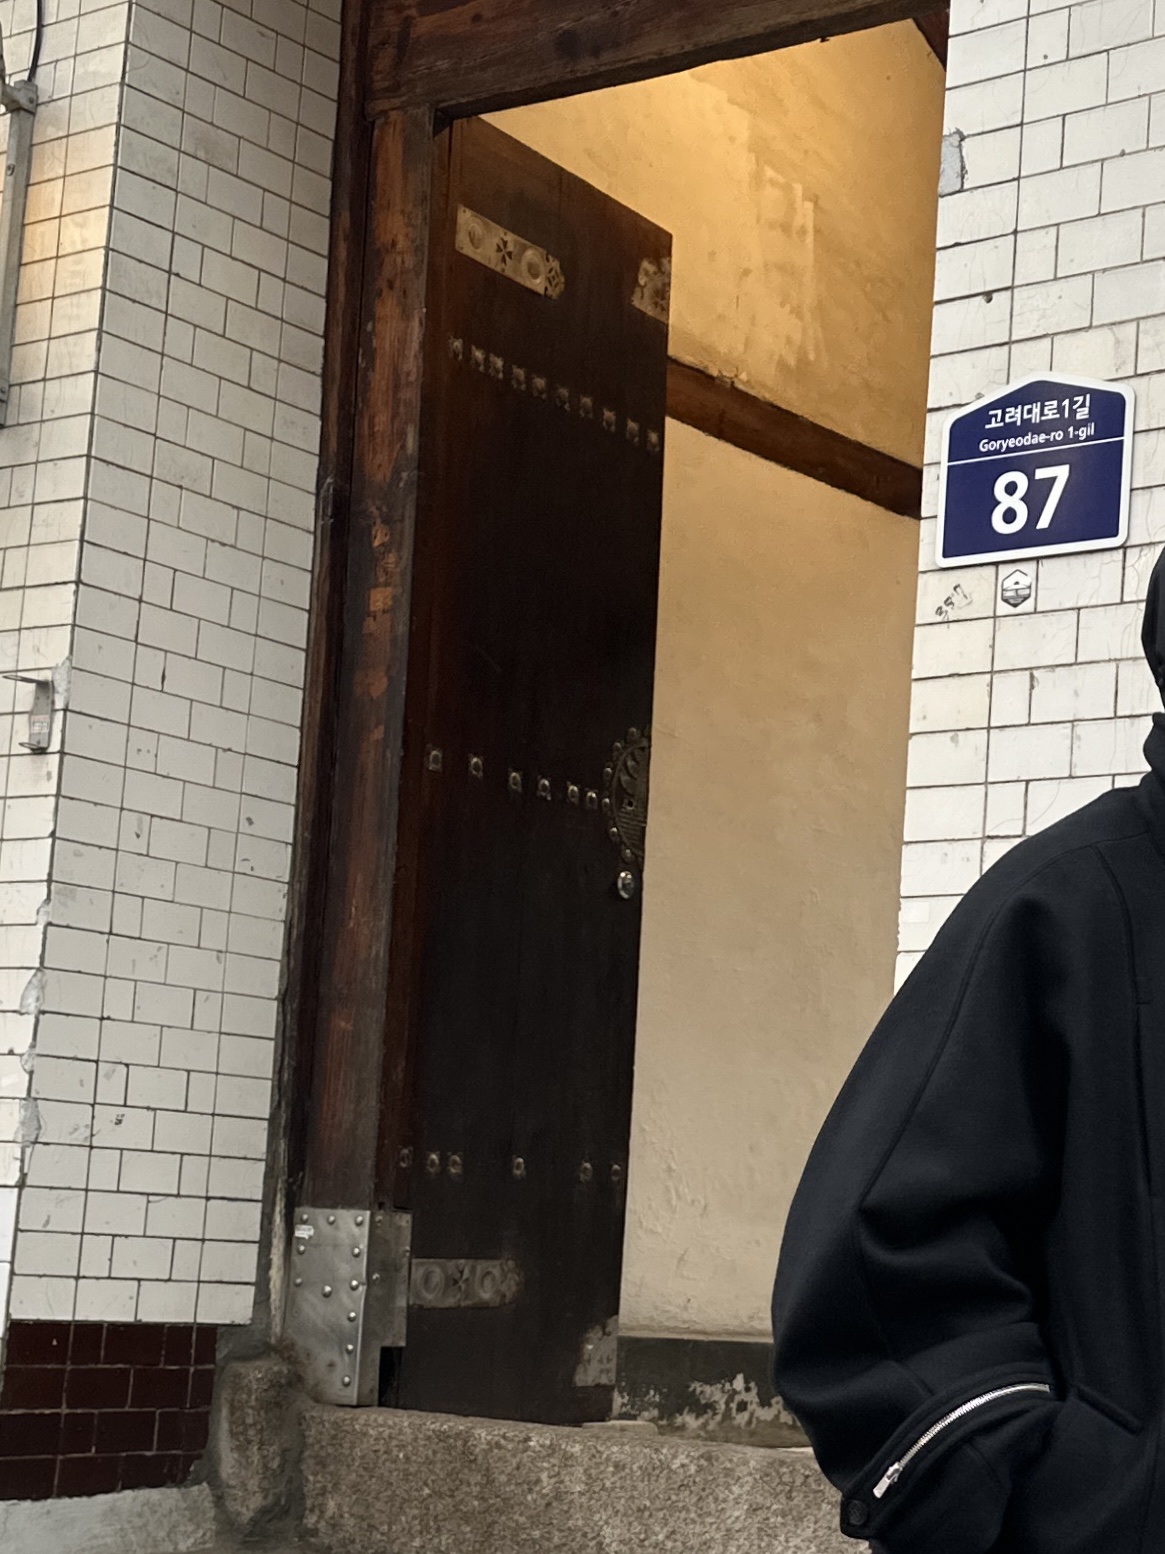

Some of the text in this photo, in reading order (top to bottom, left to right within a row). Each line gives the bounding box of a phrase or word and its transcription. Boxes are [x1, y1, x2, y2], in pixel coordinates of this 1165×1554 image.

[985, 393, 1091, 429] 고려대로1길
[979, 422, 1095, 452] Goryeodae-ro 1-gil
[991, 464, 1070, 535] 87
